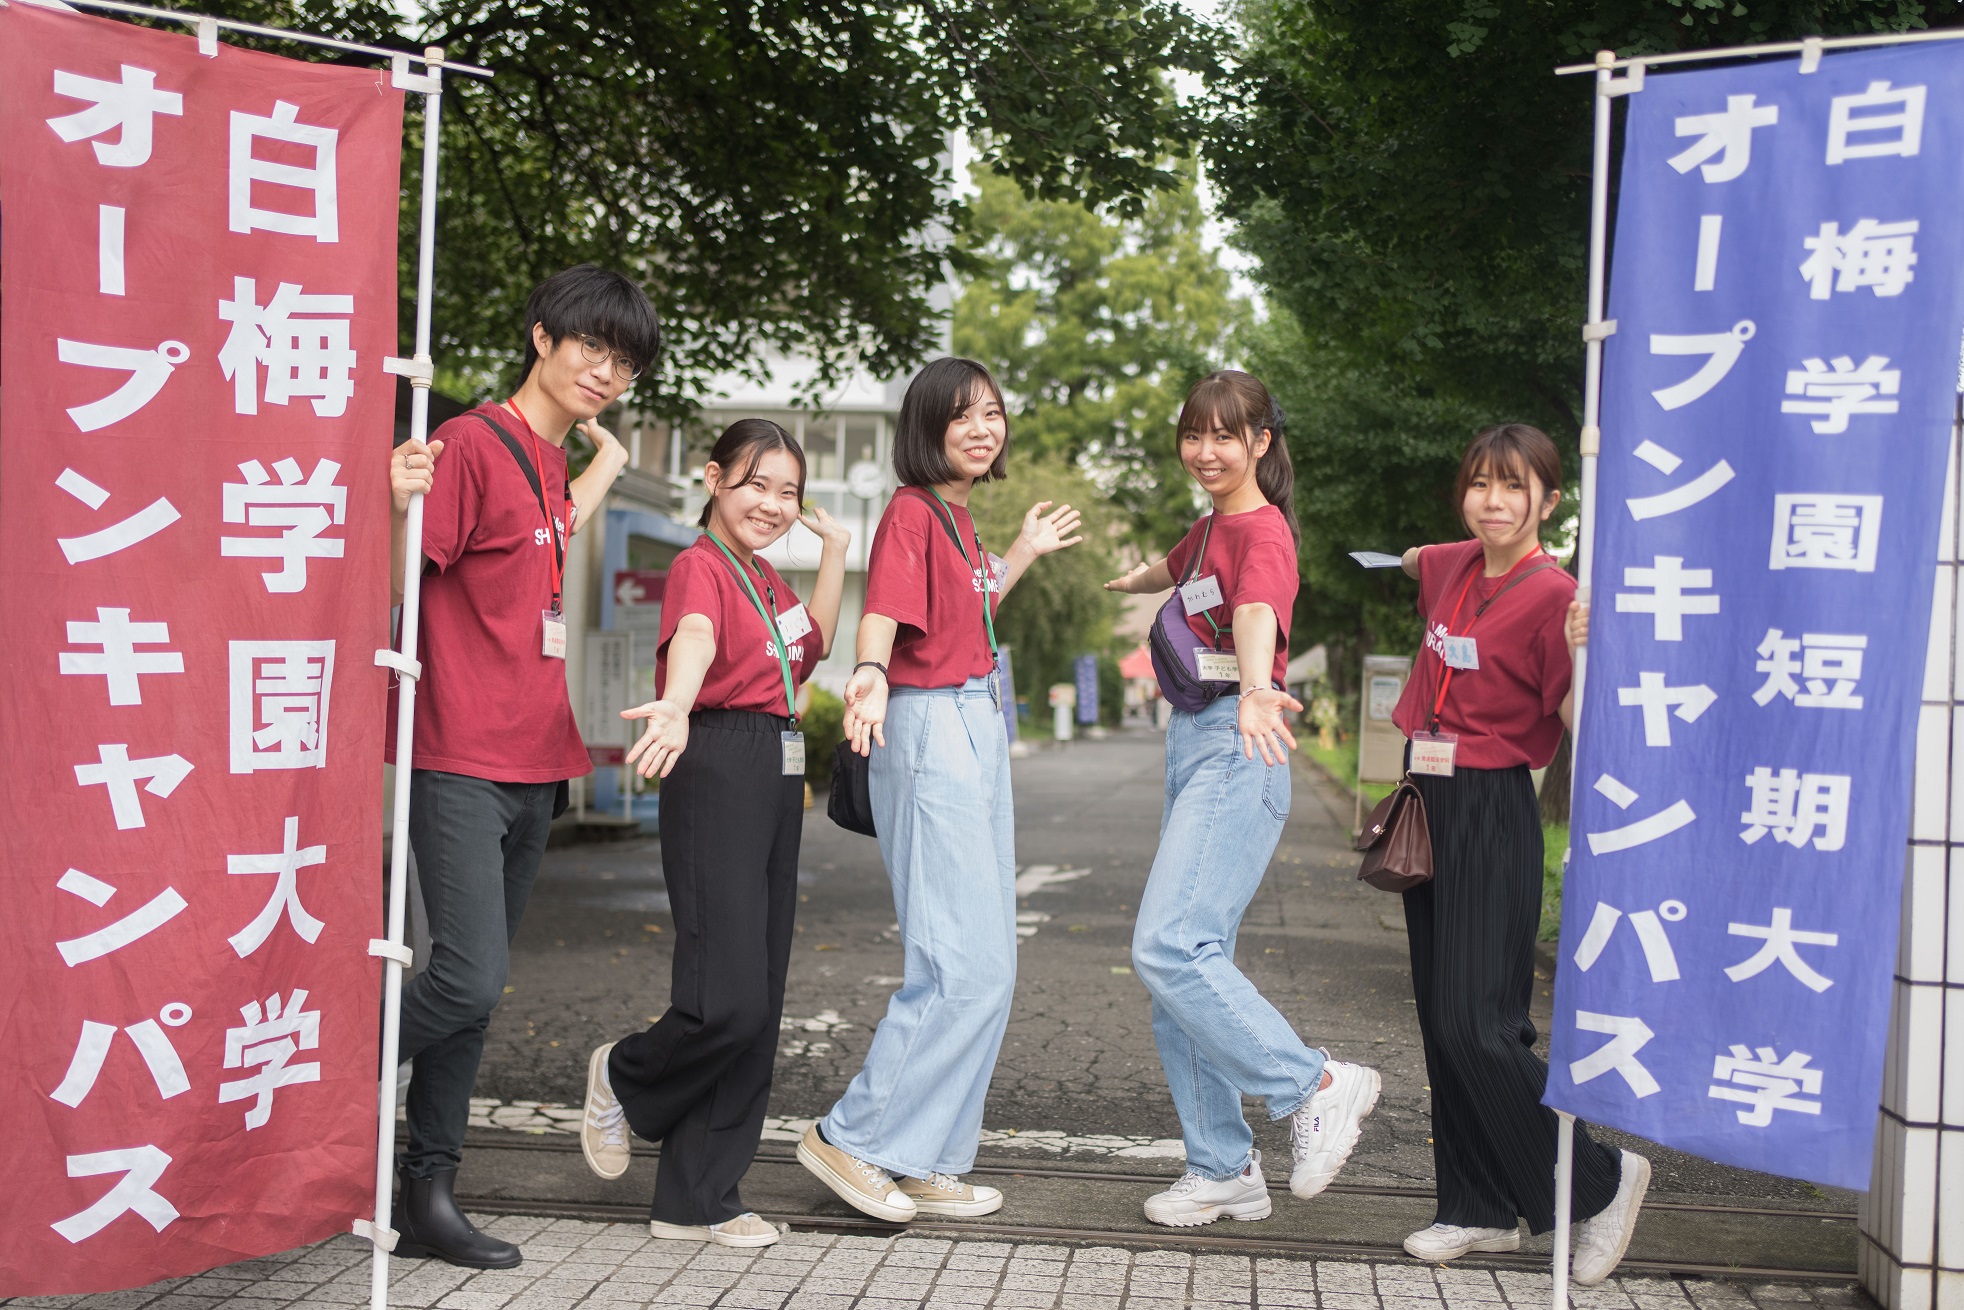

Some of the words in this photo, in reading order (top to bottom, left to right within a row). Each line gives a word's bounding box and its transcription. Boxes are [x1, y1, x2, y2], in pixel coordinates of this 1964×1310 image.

[45, 63, 195, 1244] オープンキャンパス
[217, 98, 357, 1132] 白梅学園大学
[1569, 93, 1779, 1099] オープンキャンパス
[1707, 79, 1928, 1128] 白梅学園短期大学
